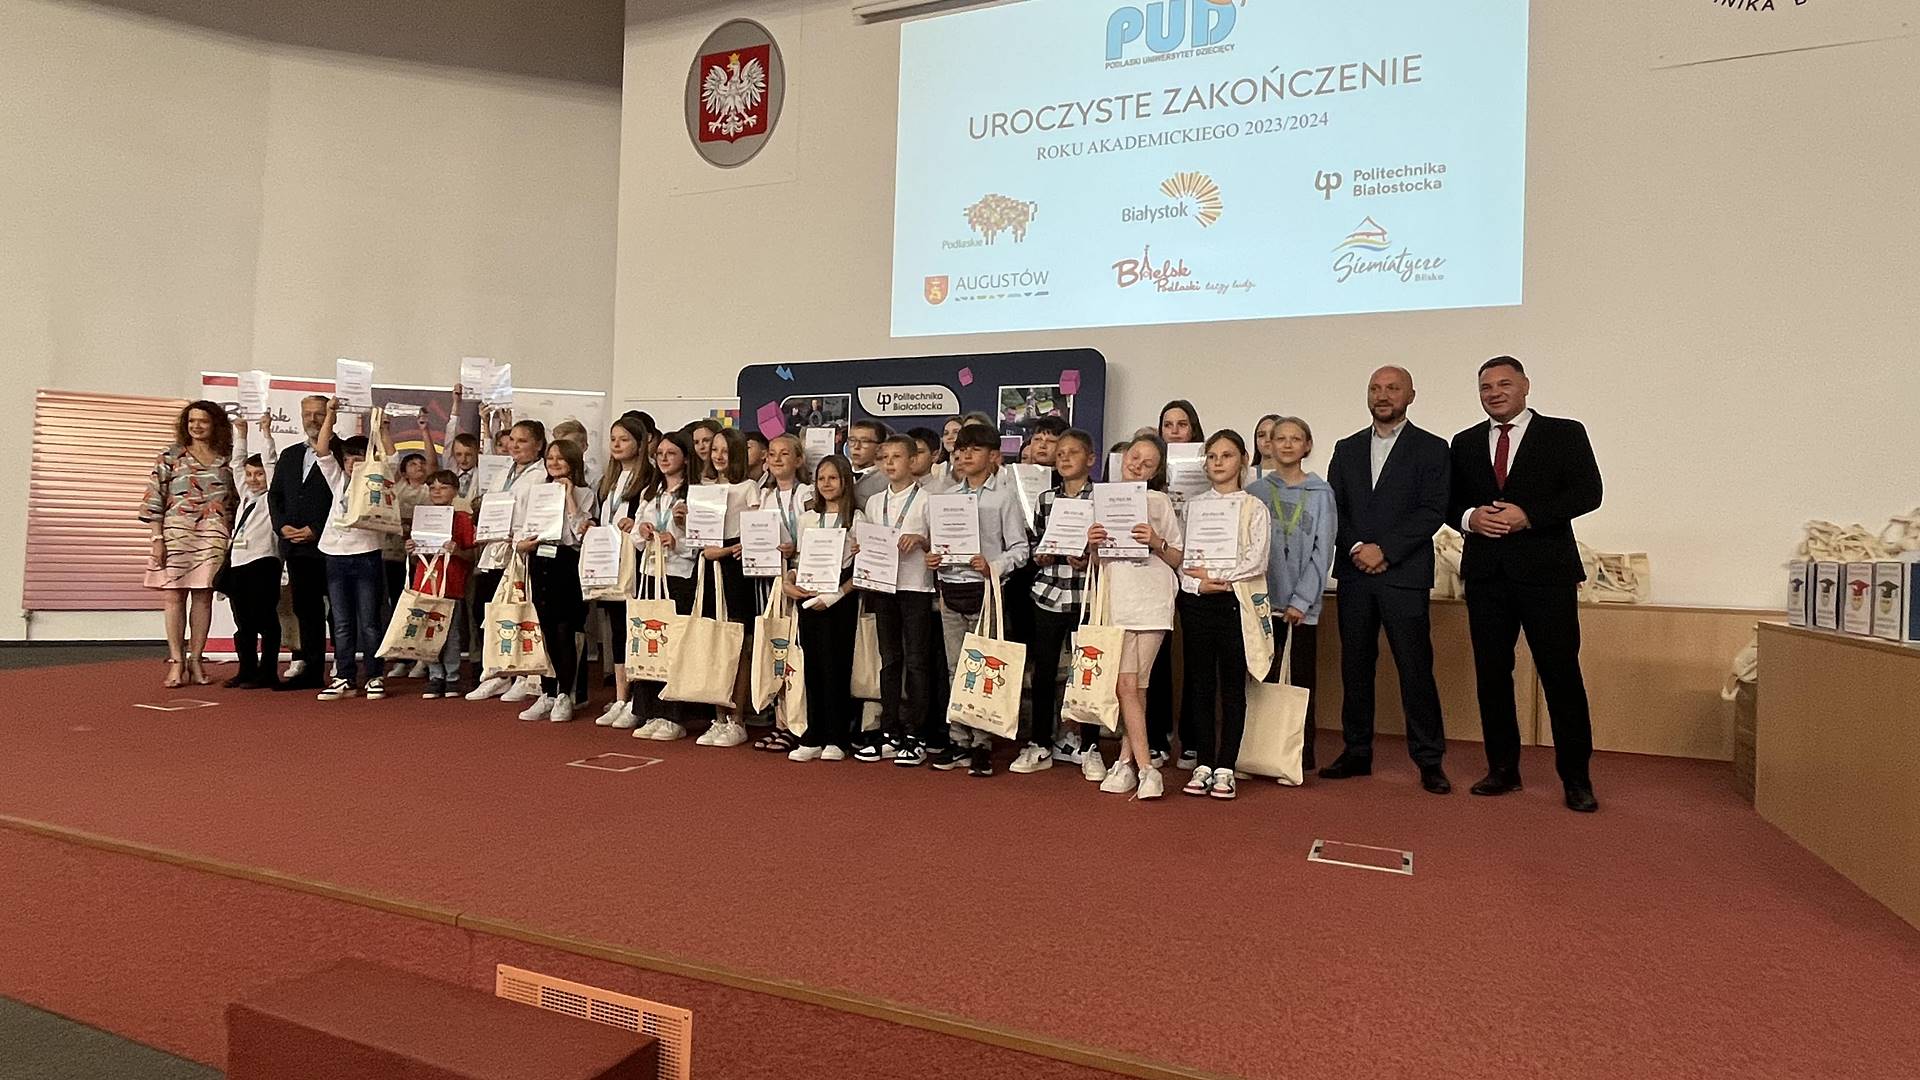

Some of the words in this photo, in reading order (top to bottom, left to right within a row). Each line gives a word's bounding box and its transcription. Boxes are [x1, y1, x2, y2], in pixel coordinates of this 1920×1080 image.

[1713, 0, 1775, 11] NIKA
[1105, 0, 1237, 61] PUD
[1105, 58, 1141, 70] PODLASKI
[1143, 50, 1194, 64] UNIWERSYTET
[1196, 43, 1236, 56] DZIECIĘCY
[969, 92, 1152, 139] UROCZYSTE
[1162, 54, 1423, 115] ZAKOŃCZENIE
[1037, 142, 1083, 160] ROKU
[1088, 123, 1239, 155] AKADEMICKIEGO
[1245, 111, 1329, 136] 2023/2024
[1353, 162, 1447, 182] Politechnika
[1353, 178, 1442, 197] Białostocka
[1121, 201, 1189, 224] Białystok
[942, 238, 983, 250] Podlaskie
[1333, 247, 1446, 283] Siemiatycze
[955, 268, 1049, 291] AUGUSTÓW
[1153, 277, 1201, 293] Podlaski
[893, 392, 943, 401] Politechnika
